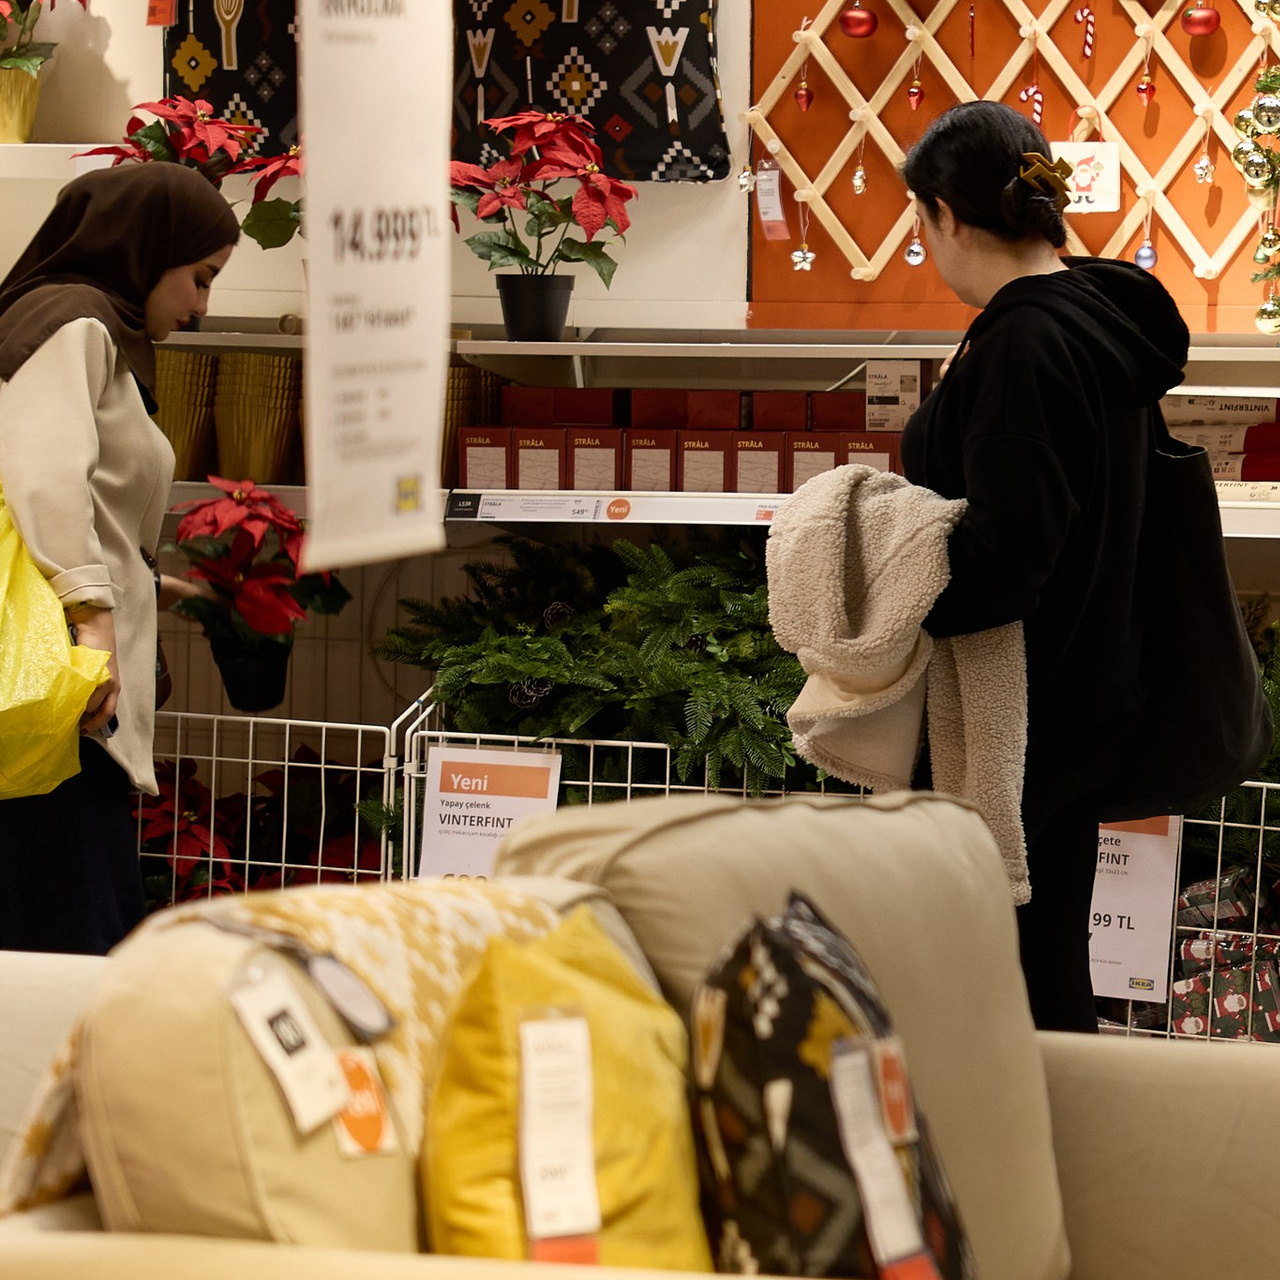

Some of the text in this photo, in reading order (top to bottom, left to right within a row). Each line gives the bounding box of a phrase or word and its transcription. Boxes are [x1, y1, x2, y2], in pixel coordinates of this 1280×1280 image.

[1219, 403, 1270, 412] VINTERFINT
[465, 436, 491, 444] STRÅLA
[518, 438, 545, 447] STRÅLA
[574, 437, 600, 446] STRÅLA
[631, 438, 656, 446] STRÅLA
[684, 440, 709, 449] STRÅLA
[737, 439, 763, 449] STRÅLA
[793, 440, 819, 450] STRÅLA
[847, 441, 874, 450] STRÅLA
[571, 508, 585, 516] 549
[609, 505, 628, 514] Yeni
[450, 773, 488, 791] Yeni
[440, 798, 491, 810] Yapay çelenk
[438, 813, 514, 829] VINTERFINT
[1117, 914, 1135, 930] TL
